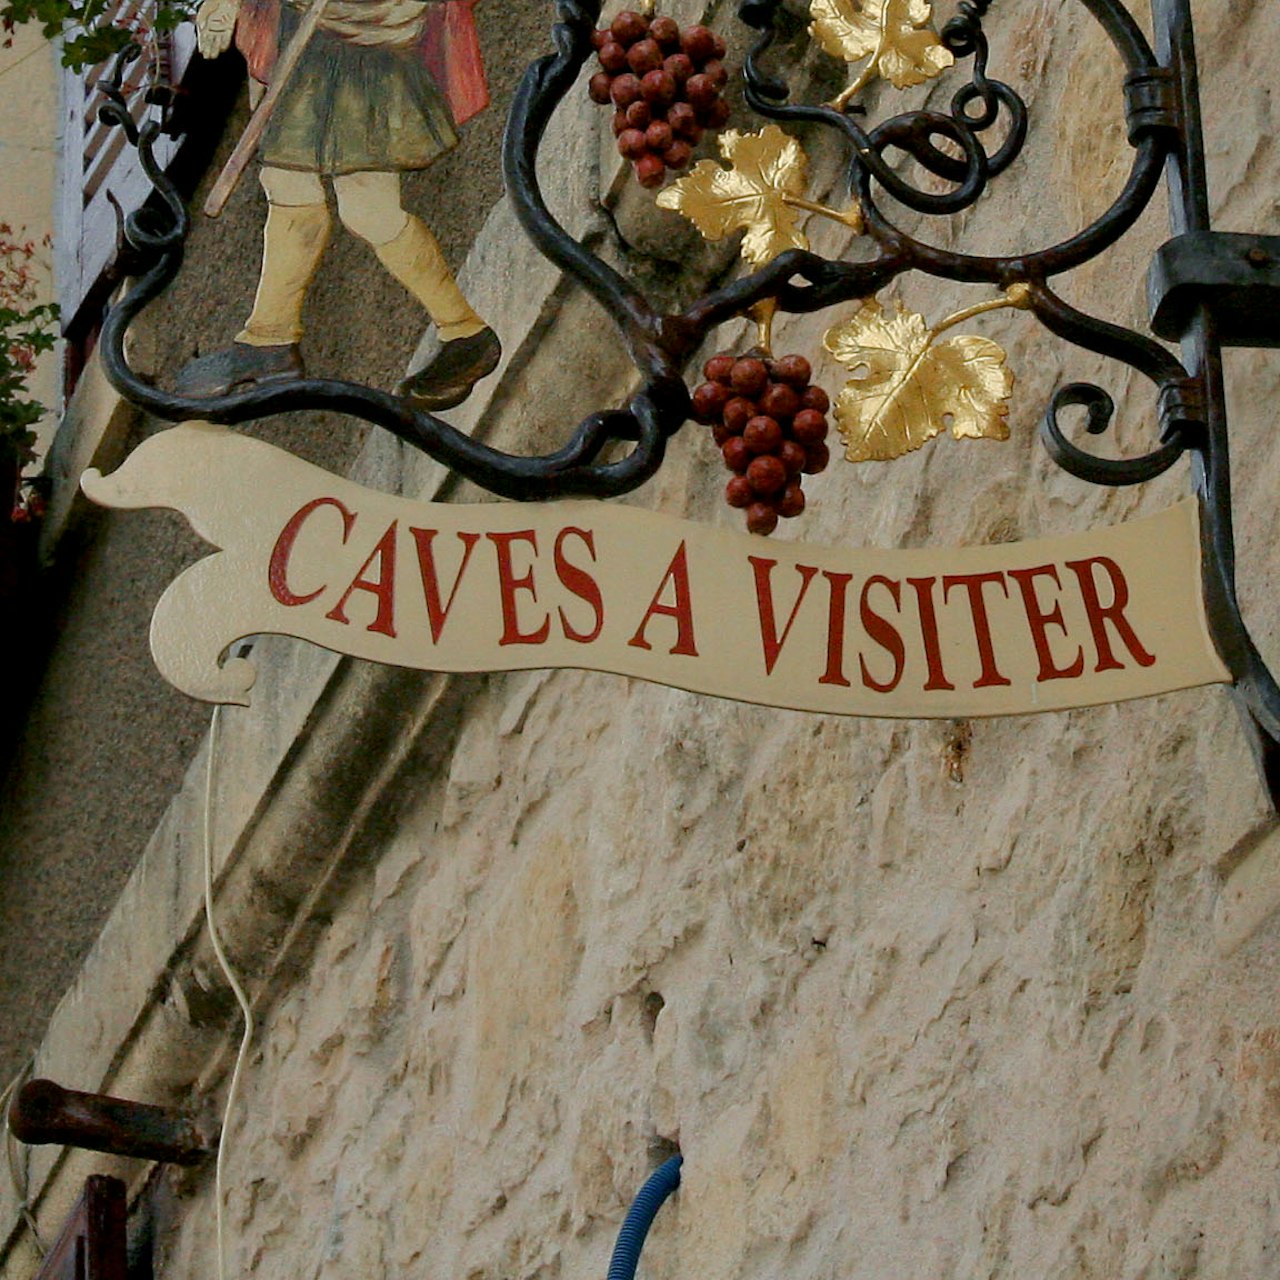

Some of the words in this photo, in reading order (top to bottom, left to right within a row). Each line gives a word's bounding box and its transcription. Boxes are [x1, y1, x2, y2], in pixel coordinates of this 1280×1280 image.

[268, 496, 607, 646] CAVES
[627, 540, 699, 657] A
[748, 555, 1157, 693] VISITER
